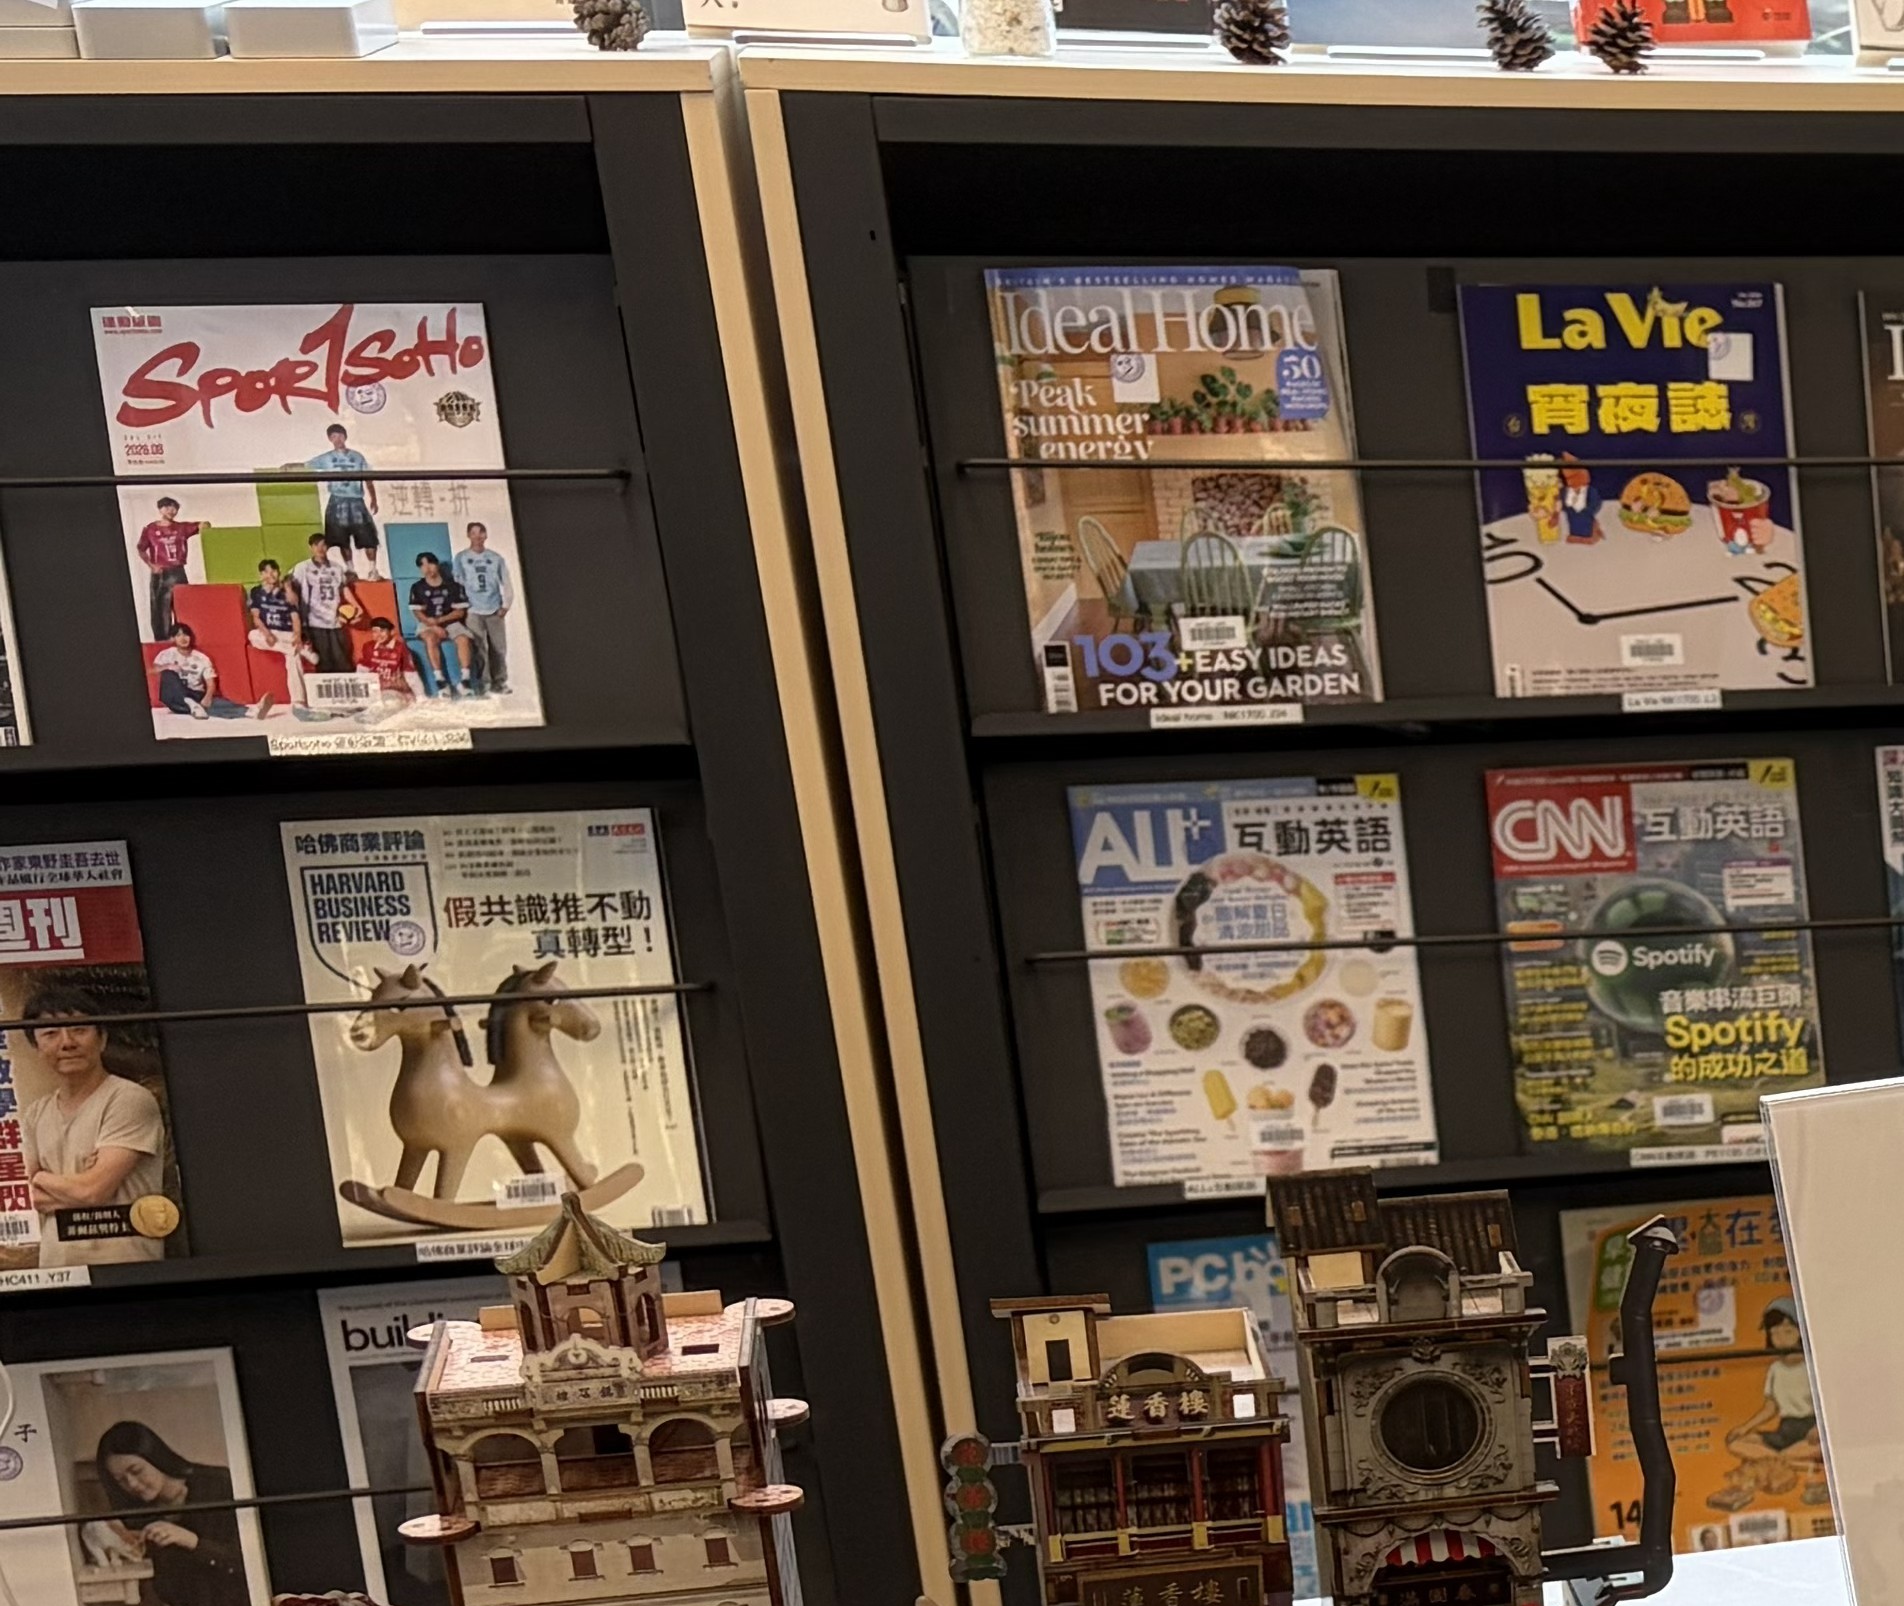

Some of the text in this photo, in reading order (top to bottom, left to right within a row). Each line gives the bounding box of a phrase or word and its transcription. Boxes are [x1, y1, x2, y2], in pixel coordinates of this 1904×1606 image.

[1001, 287, 1320, 356] Ideal Home
[1281, 354, 1323, 380] 50
[1010, 377, 1098, 415] Peak
[1012, 409, 1150, 438] summer
[1039, 435, 1155, 459] energy
[1195, 647, 1264, 674] EASY
[1269, 645, 1350, 670] IDEAS
[1099, 672, 1362, 706] FOR YOUR GARDEN
[1233, 815, 1393, 857] 互動英語
[1493, 795, 1633, 863] CNN
[1642, 801, 1787, 842] 互動英語
[294, 829, 426, 855] 哈佛商業評論
[308, 870, 405, 896] HARVARD
[313, 894, 412, 920] BUSINESS
[443, 889, 653, 930] 假共識推不動
[316, 919, 392, 945] REVIEW
[531, 926, 655, 959] 真轉型！
[1632, 943, 1717, 970] Spotify
[1659, 985, 1803, 1015] 音樂串流巨頭
[1664, 1010, 1804, 1052] Spotify
[1670, 1047, 1809, 1082] 的成功之道
